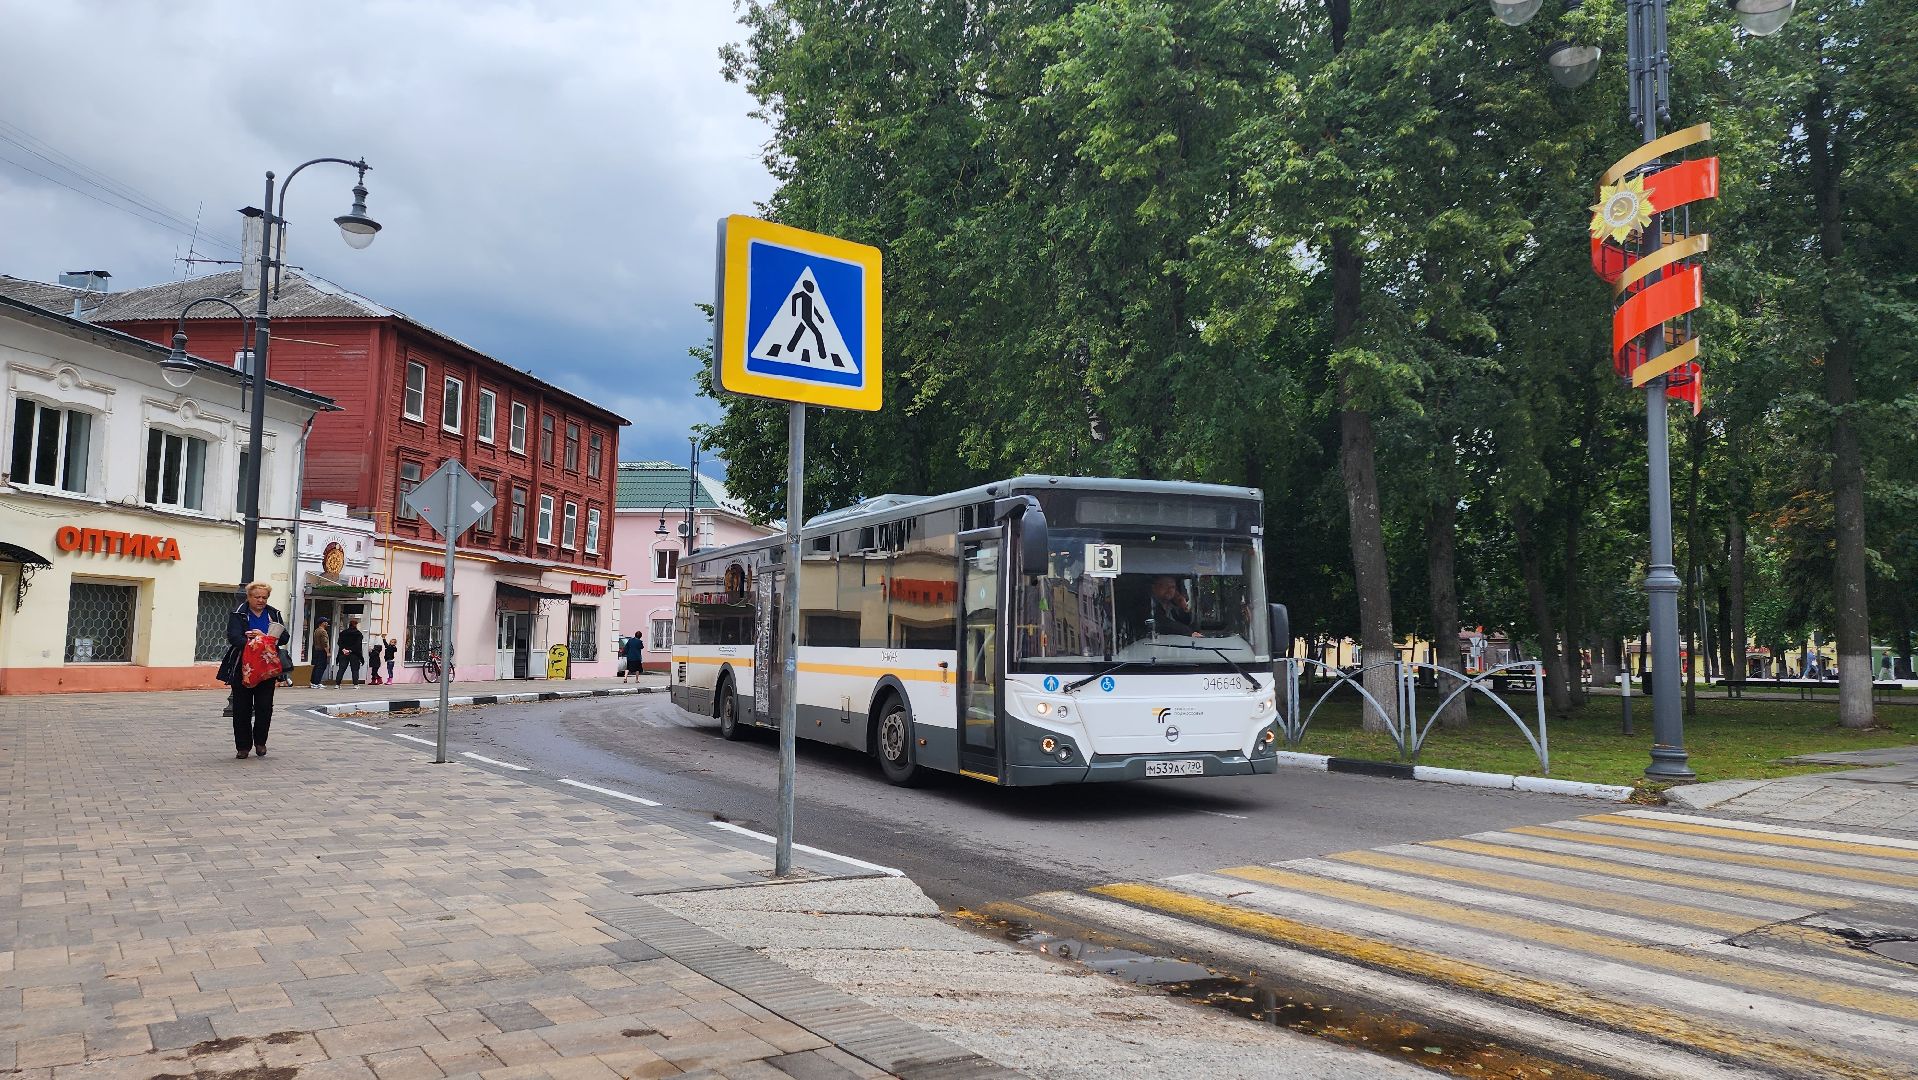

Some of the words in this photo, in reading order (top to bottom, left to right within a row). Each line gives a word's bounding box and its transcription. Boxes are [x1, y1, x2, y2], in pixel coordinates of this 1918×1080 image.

[56, 525, 181, 561] ОПТИКА
[1098, 547, 1114, 569] 3
[350, 576, 390, 589] ШАВЕРМА
[1202, 677, 1242, 690] 046648
